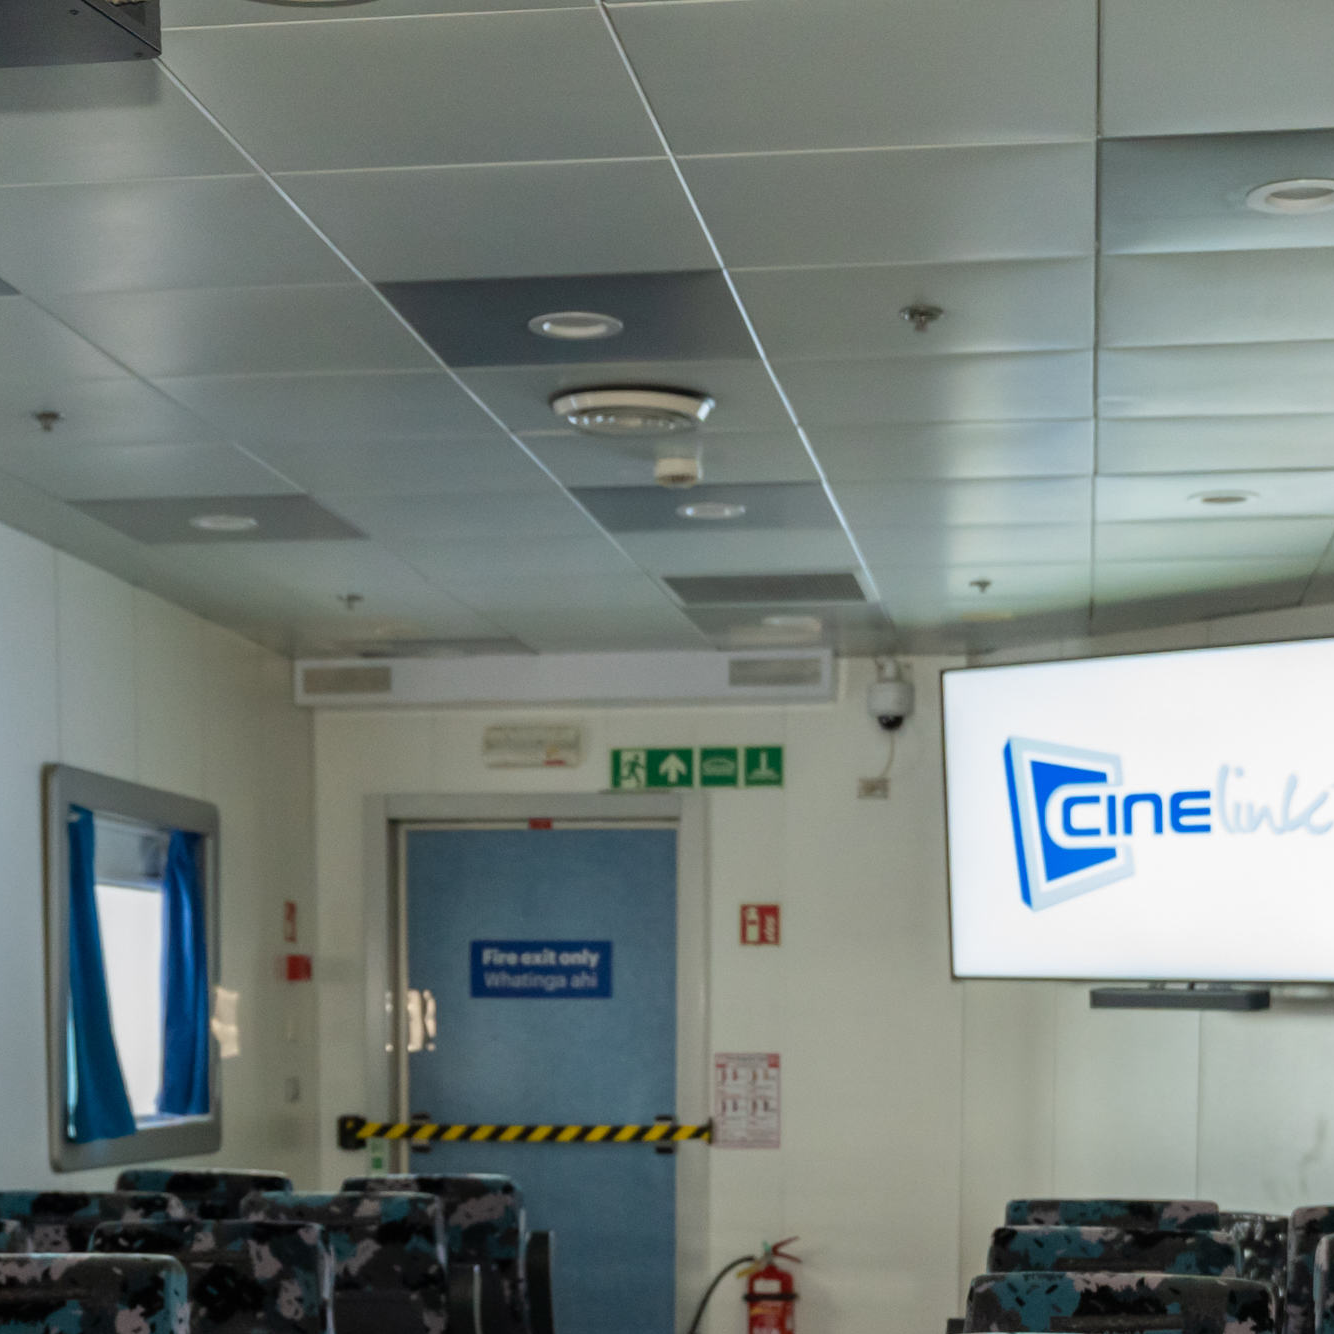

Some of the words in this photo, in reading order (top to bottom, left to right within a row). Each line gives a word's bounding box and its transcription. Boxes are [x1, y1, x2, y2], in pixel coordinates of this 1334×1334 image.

[482, 948, 517, 966] Fire
[520, 948, 557, 966] exit
[558, 949, 600, 968] only
